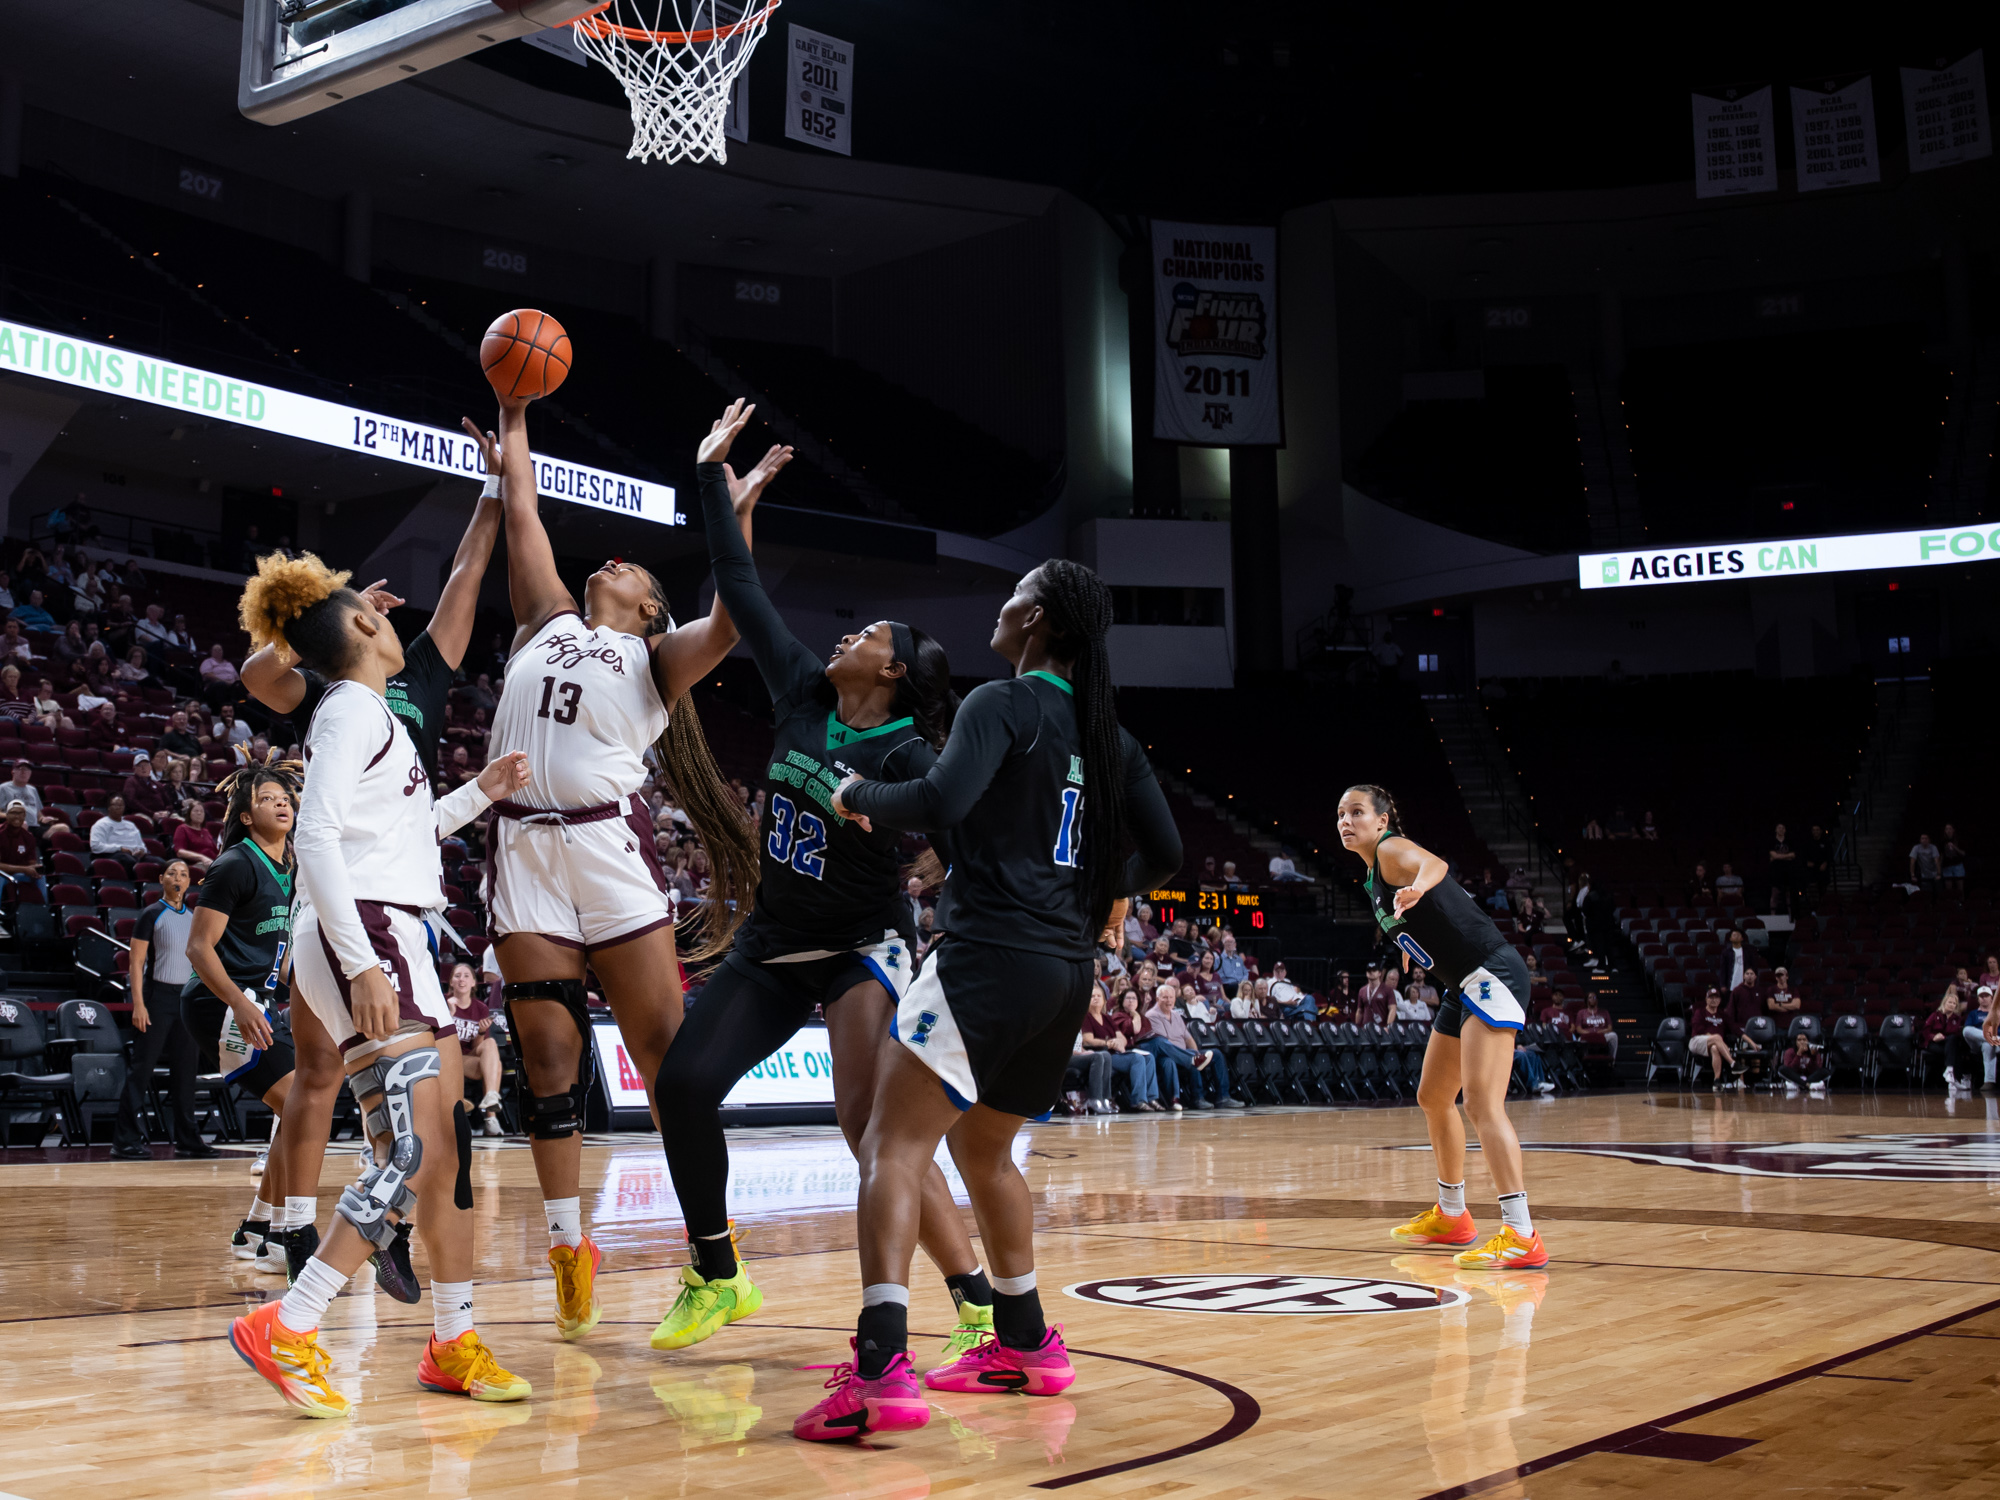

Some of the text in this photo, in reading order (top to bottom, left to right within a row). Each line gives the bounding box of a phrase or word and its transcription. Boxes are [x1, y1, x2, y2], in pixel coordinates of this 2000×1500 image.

[795, 39, 818, 54] GARY
[821, 47, 847, 64] BLAIR
[802, 61, 838, 91] 2011
[1931, 72, 1954, 83] NCAA
[1721, 104, 1743, 113] NCAA
[1819, 96, 1842, 106] NCAA
[1949, 104, 1976, 119] 2012
[802, 108, 836, 140] 852
[1735, 124, 1760, 137] 1982
[1835, 115, 1862, 129] 1998
[1951, 117, 1977, 133] 2014
[1736, 138, 1762, 150] 1986
[1836, 129, 1864, 143] 2000
[1953, 131, 1979, 147] 2016
[1737, 152, 1763, 164] 1994
[1837, 143, 1865, 156] 2002
[1738, 166, 1764, 178] 1996
[1840, 157, 1867, 170] 2004
[179, 169, 222, 199] 207
[1173, 239, 1253, 261] NATIONAL
[482, 248, 527, 274] 208
[1162, 258, 1265, 282] CHAMPIONS
[735, 281, 781, 303] 209
[1195, 292, 1260, 320] FINAL
[1762, 295, 1799, 316] 211
[1486, 308, 1529, 327] 210
[1179, 339, 1261, 356] INDIANAPOLIS
[136, 359, 266, 423] NEEDED
[1183, 365, 1250, 397] 2011
[1629, 550, 1745, 581] AGGIES
[1757, 543, 1819, 571] CAN
[535, 633, 626, 676] Aggies
[537, 676, 583, 726] 13
[386, 698, 424, 730] HRISTI
[785, 749, 822, 775] TEXAS
[768, 762, 808, 789] CORPUS
[767, 792, 828, 882] 32
[1198, 891, 1228, 910] 2:31
[1236, 893, 1251, 906] A&M
[1161, 907, 1174, 923] 11
[1251, 910, 1264, 929] 10
[745, 1052, 799, 1079] GGIE
